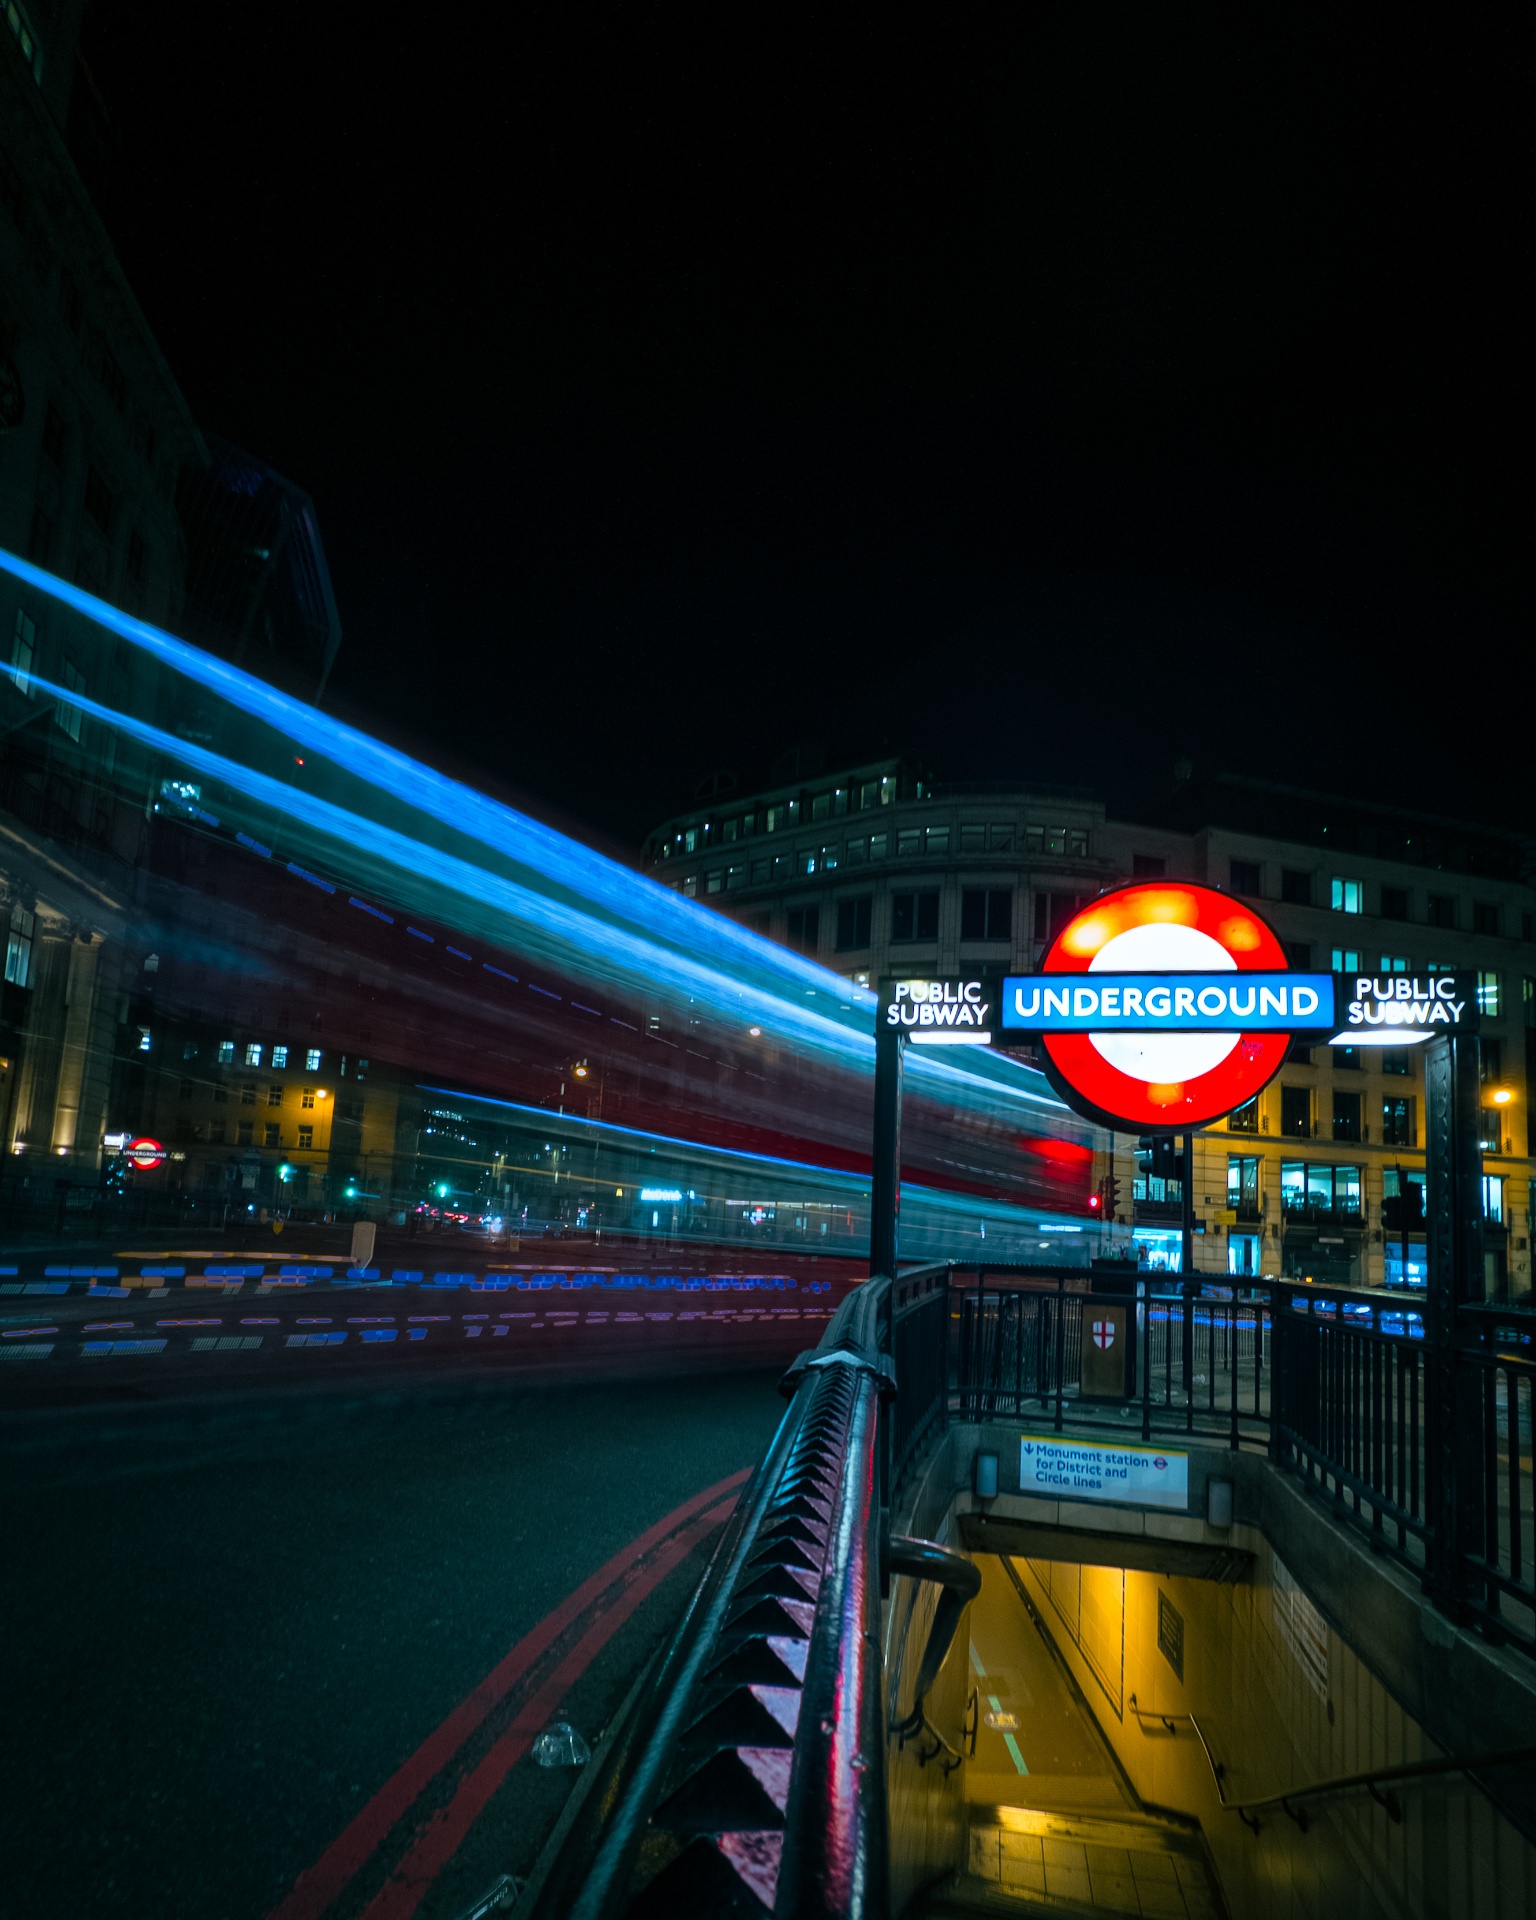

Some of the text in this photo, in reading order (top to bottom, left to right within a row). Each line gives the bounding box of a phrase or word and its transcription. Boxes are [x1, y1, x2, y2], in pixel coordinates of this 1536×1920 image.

[895, 981, 982, 1003] PUBLIC
[1355, 978, 1456, 1001] PUBLIC
[1015, 986, 1319, 1017] UNDERGROUND
[1348, 1001, 1465, 1025] SUBWAY
[886, 1003, 989, 1026] SUBWAY
[123, 1150, 167, 1158] UNDERGROUND
[1036, 1445, 1149, 1468] Monument station
[1036, 1457, 1127, 1479] for District and
[1035, 1470, 1102, 1489] Circle lines
